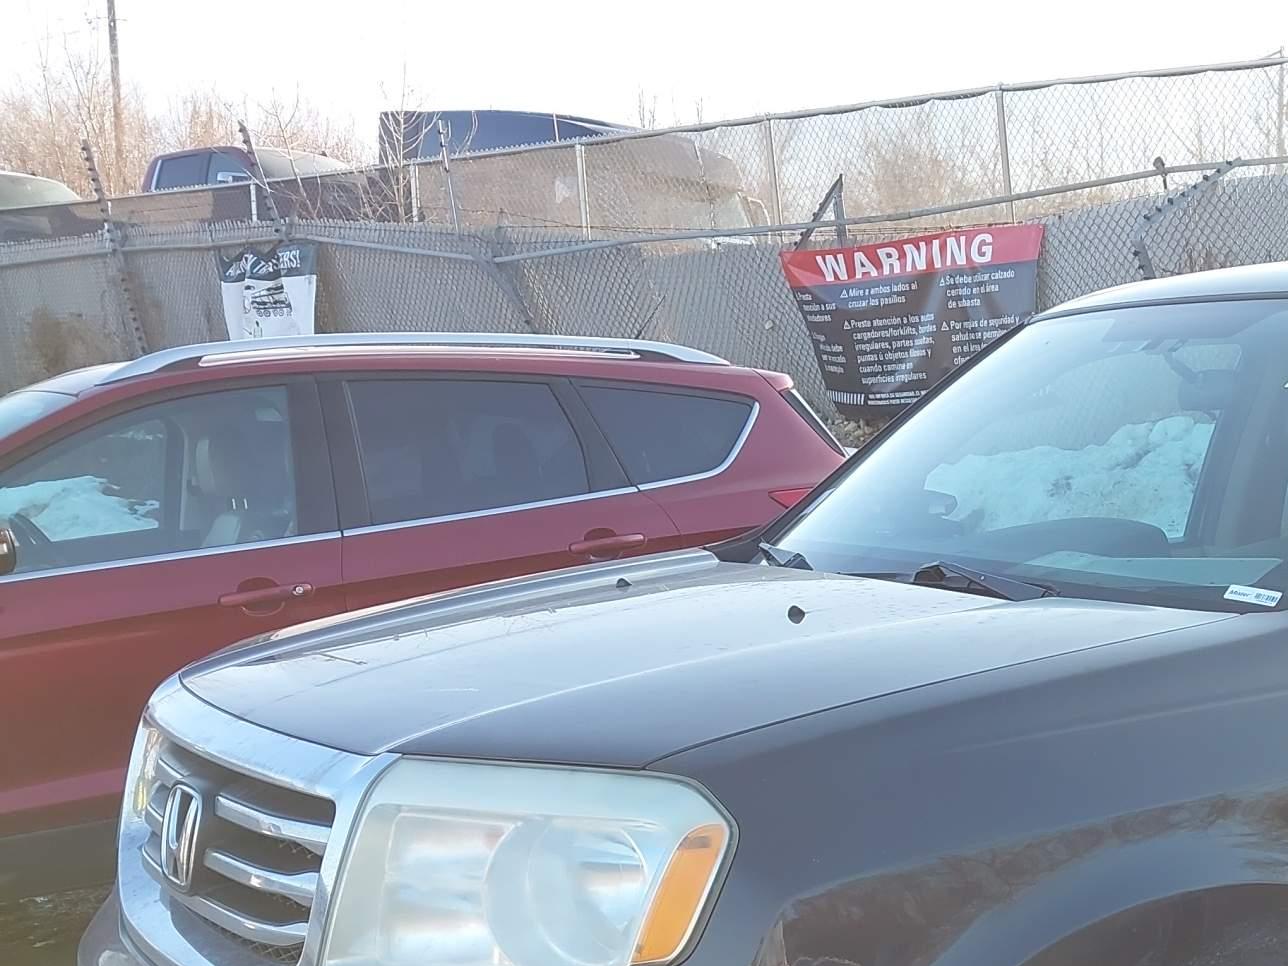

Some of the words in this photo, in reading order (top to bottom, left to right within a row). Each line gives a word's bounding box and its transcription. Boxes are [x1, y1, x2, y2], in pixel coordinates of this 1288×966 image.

[815, 233, 993, 282] WARNING
[991, 268, 1015, 280] calzado
[849, 287, 864, 297] Mire
[892, 280, 909, 292] lados
[848, 299, 868, 308] cruzar
[869, 297, 879, 306] los
[880, 294, 906, 308] pasillos
[948, 298, 956, 309] de
[909, 314, 919, 322] los
[950, 320, 963, 330] Por
[980, 317, 988, 327] de
[952, 345, 962, 354] en
